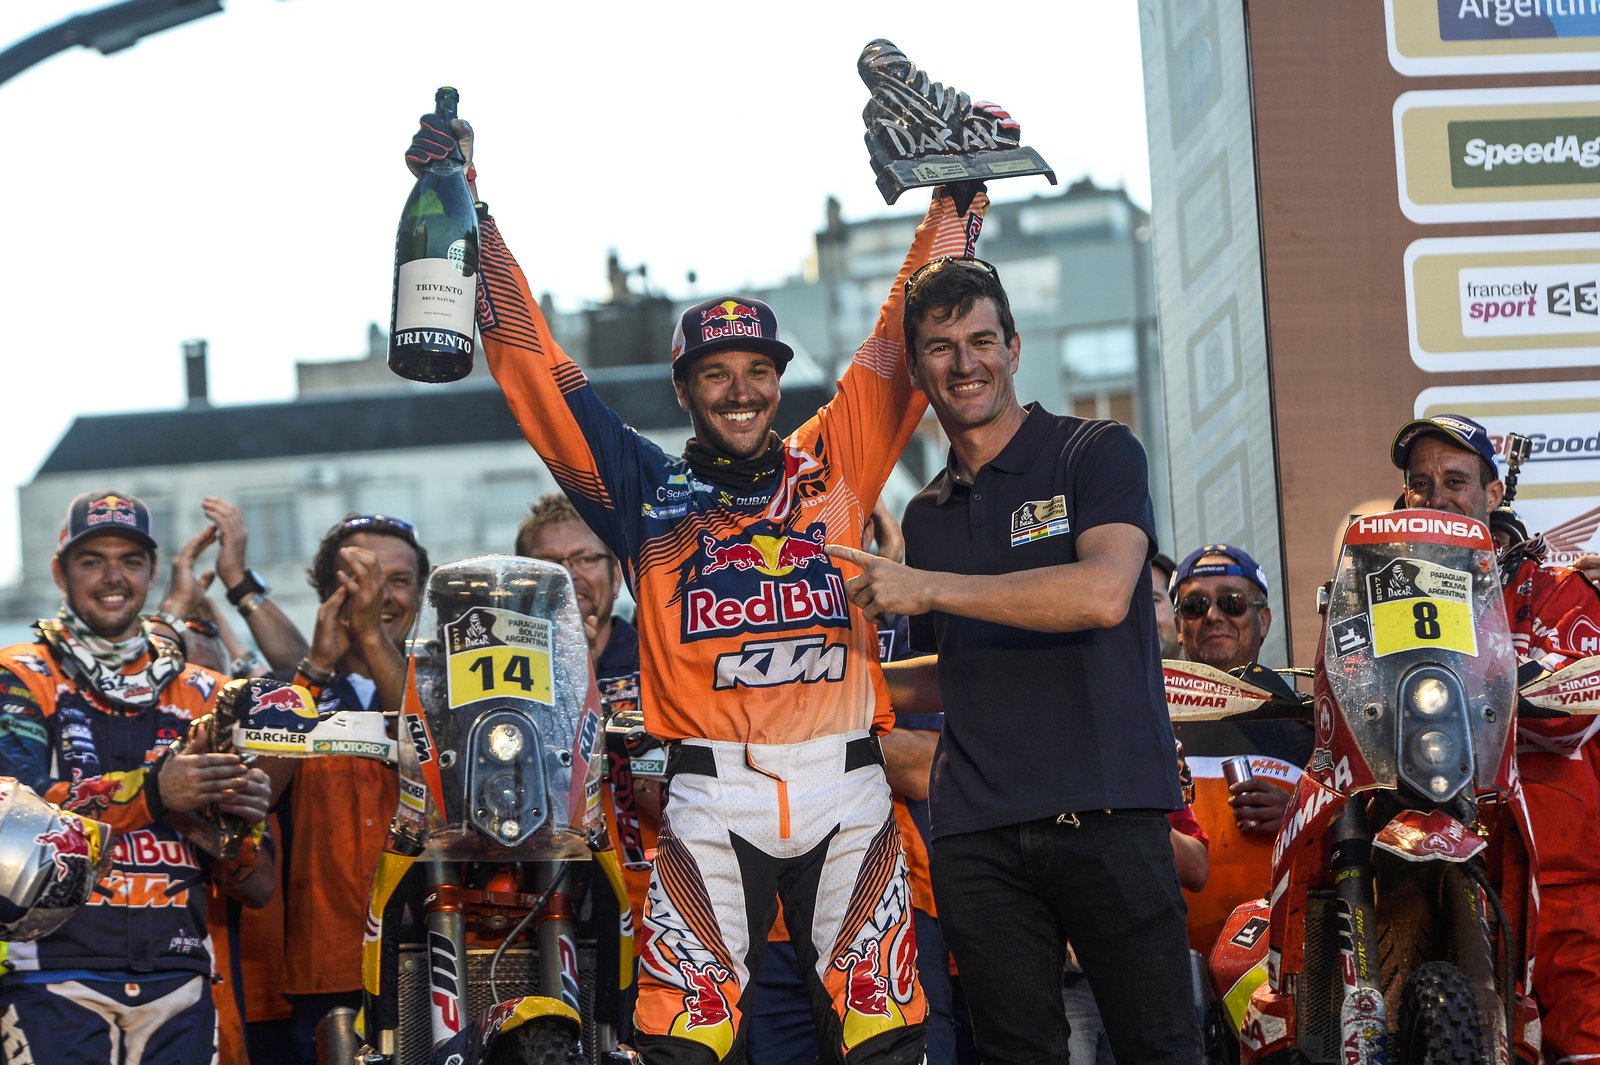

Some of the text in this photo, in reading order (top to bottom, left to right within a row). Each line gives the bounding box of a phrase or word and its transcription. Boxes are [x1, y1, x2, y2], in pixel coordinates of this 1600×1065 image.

[1458, 0, 1600, 27] Argentin
[881, 118, 1019, 158] DAKAR
[415, 284, 463, 296] TRIVENTO
[1467, 281, 1538, 297] francetv
[1469, 297, 1537, 323] sport
[702, 320, 763, 341] Red Bull
[395, 332, 472, 354] TRIVENTO
[87, 511, 136, 526] Red Bull
[1359, 518, 1484, 540] HIMOINSA
[1430, 571, 1467, 582] PARAGUAY
[1441, 580, 1467, 591] BOLIVIA
[1374, 577, 1382, 601] 2017
[1388, 585, 1413, 598] DAKAR
[1428, 588, 1467, 599] ARGENTINA
[687, 573, 849, 635] Red Bull
[508, 619, 549, 631] PARAGUAY
[1412, 601, 1441, 640] 8
[452, 627, 460, 652] 2017
[465, 634, 490, 647] DAKAR
[505, 635, 549, 648] ARGENTINA
[519, 628, 549, 639] BOLIVIA
[469, 655, 534, 692] 14
[713, 634, 848, 691] KTM
[1164, 675, 1242, 697] HIMOINSA
[331, 741, 386, 754] MOTOREX
[406, 714, 433, 764] KTM
[578, 708, 600, 765] KTM
[1251, 759, 1291, 773] KTM
[86, 871, 189, 908] KTM
